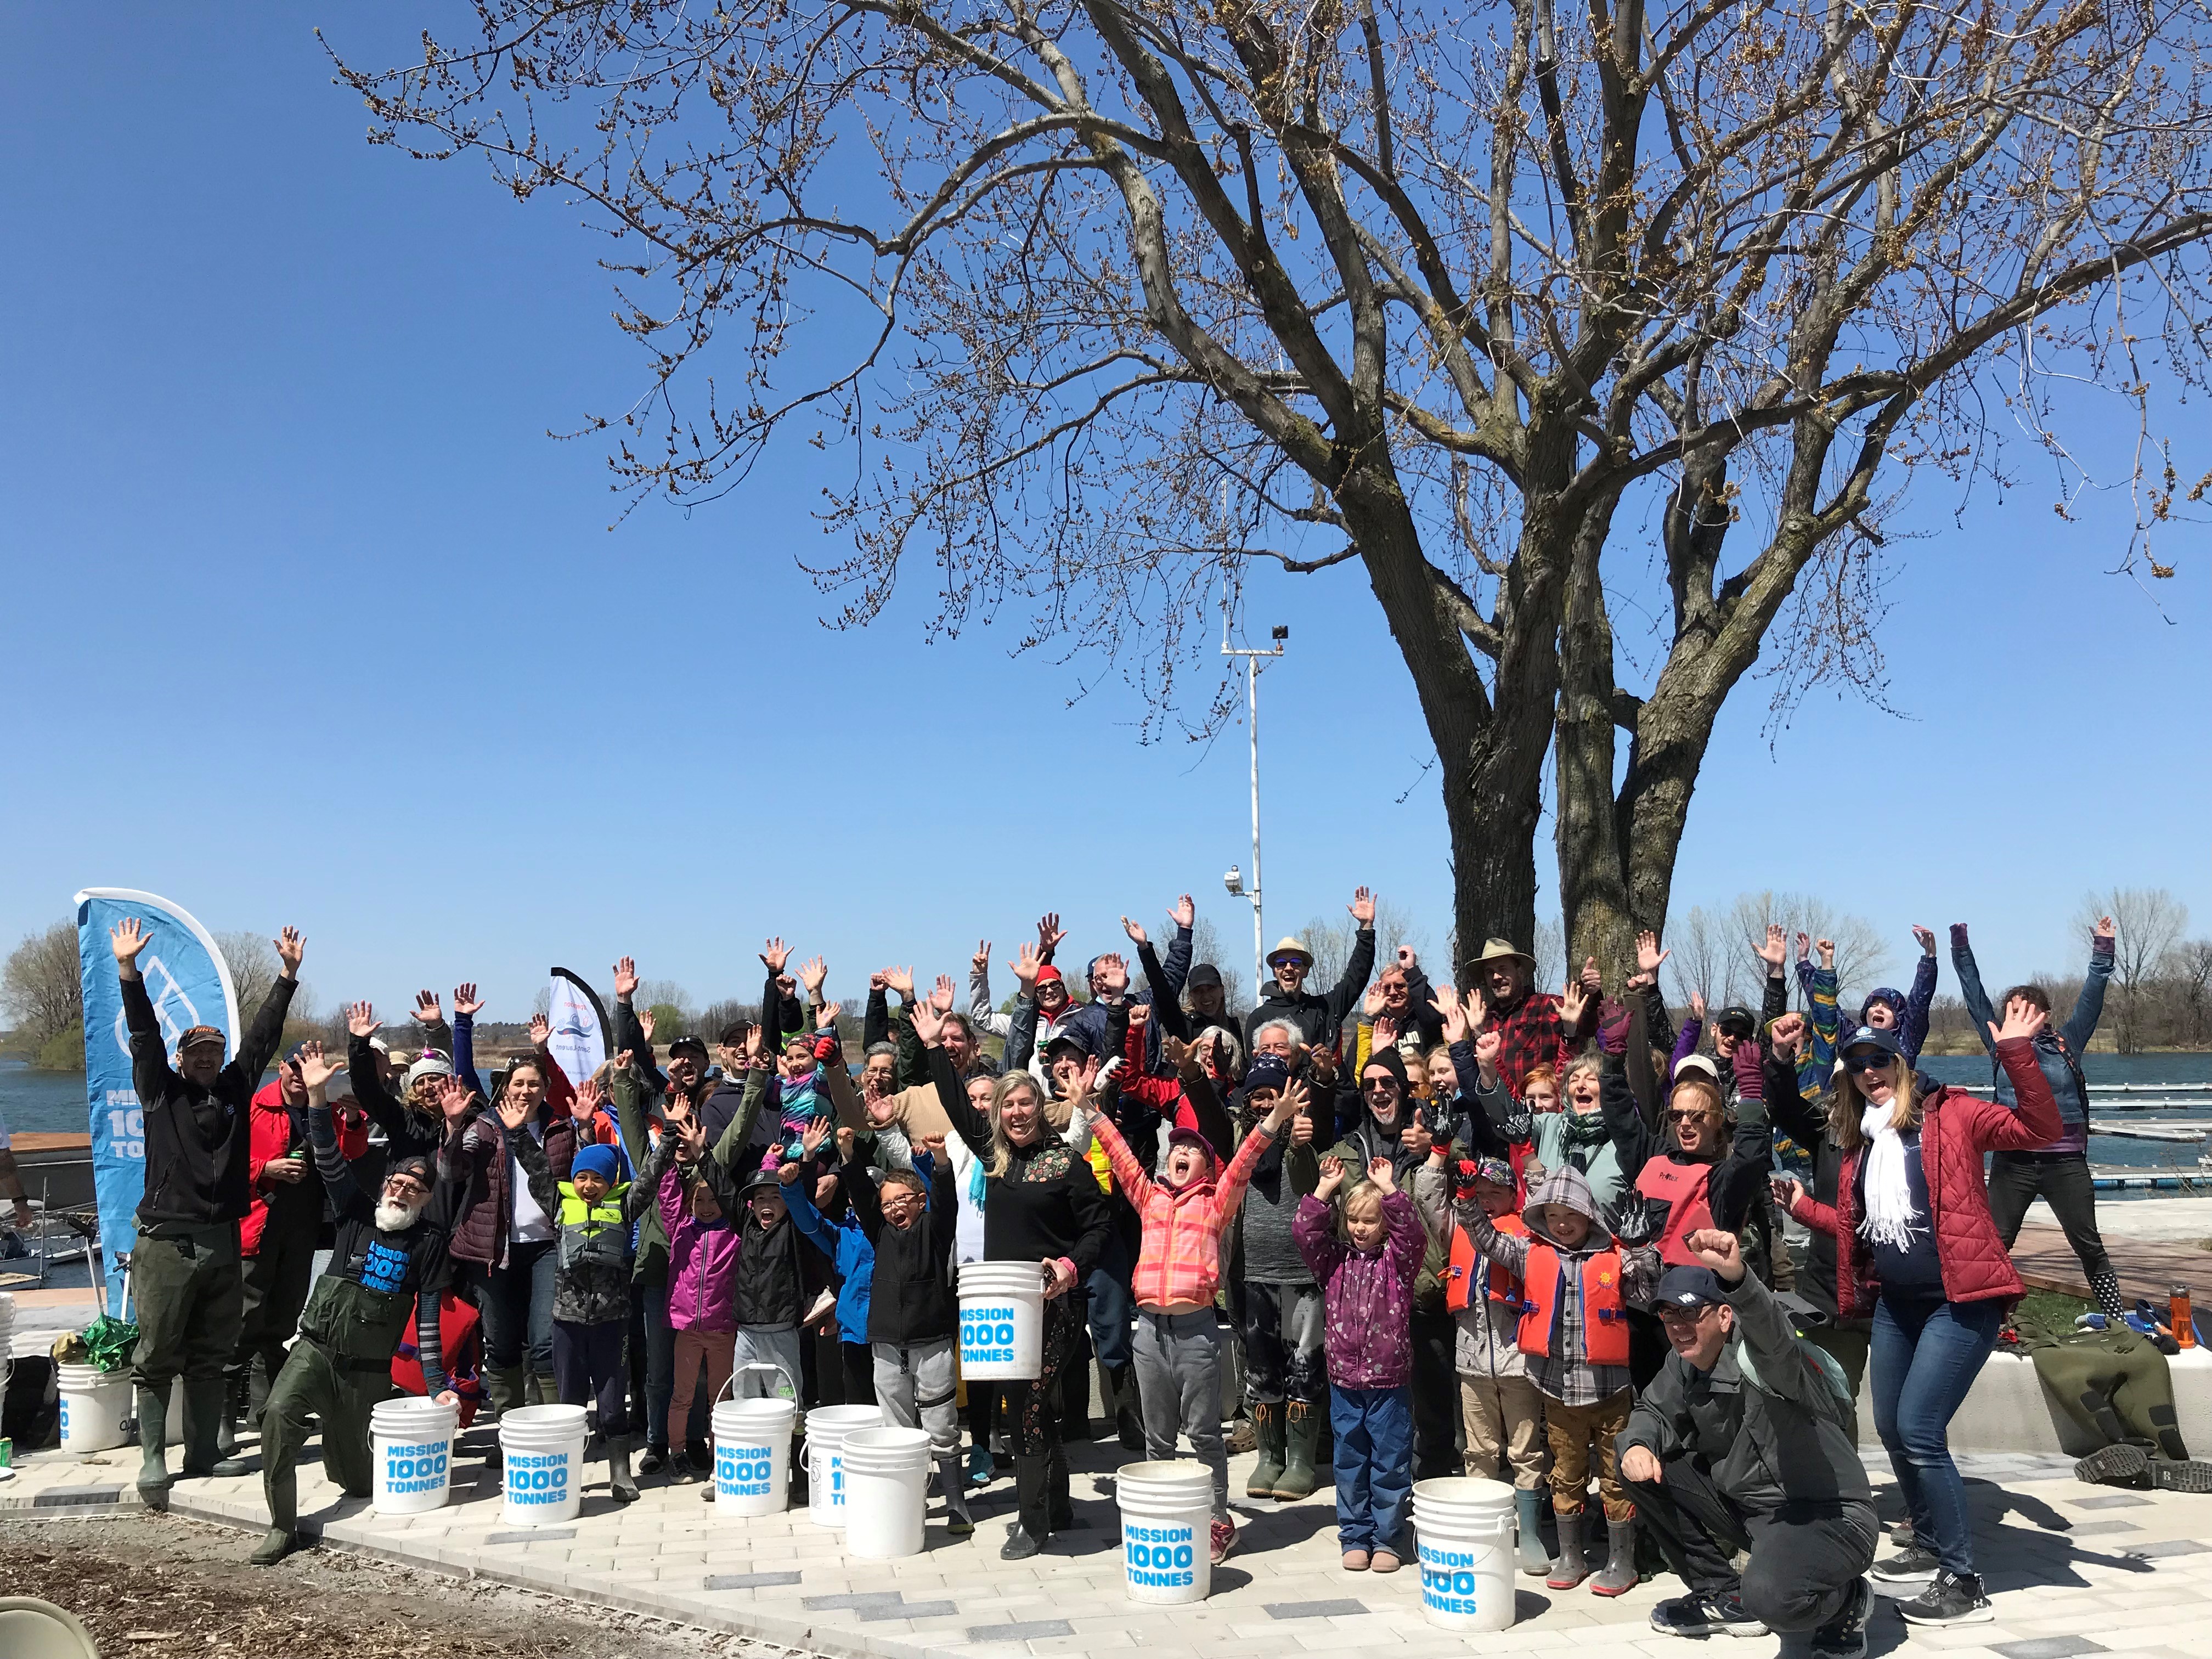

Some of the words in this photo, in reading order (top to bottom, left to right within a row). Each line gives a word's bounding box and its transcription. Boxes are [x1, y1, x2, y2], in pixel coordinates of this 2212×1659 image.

[106, 1090, 142, 1106] MI
[960, 1308, 1014, 1321] MISSION
[960, 1324, 1014, 1346] 1000
[960, 1348, 1014, 1362] TONNES
[388, 1440, 448, 1457] MISSION
[716, 1444, 771, 1460] MISSION
[387, 1454, 447, 1479] 1000
[507, 1453, 568, 1468] MISSION
[508, 1468, 568, 1490] 1000
[716, 1459, 771, 1482] 1000
[386, 1475, 446, 1493] TONNES
[716, 1480, 771, 1496] TONNES
[832, 1471, 845, 1490] 1
[507, 1489, 567, 1505] TONNES
[1126, 1523, 1192, 1543] MISSION
[1126, 1541, 1193, 1570] 1000
[1127, 1566, 1193, 1587] TONNES
